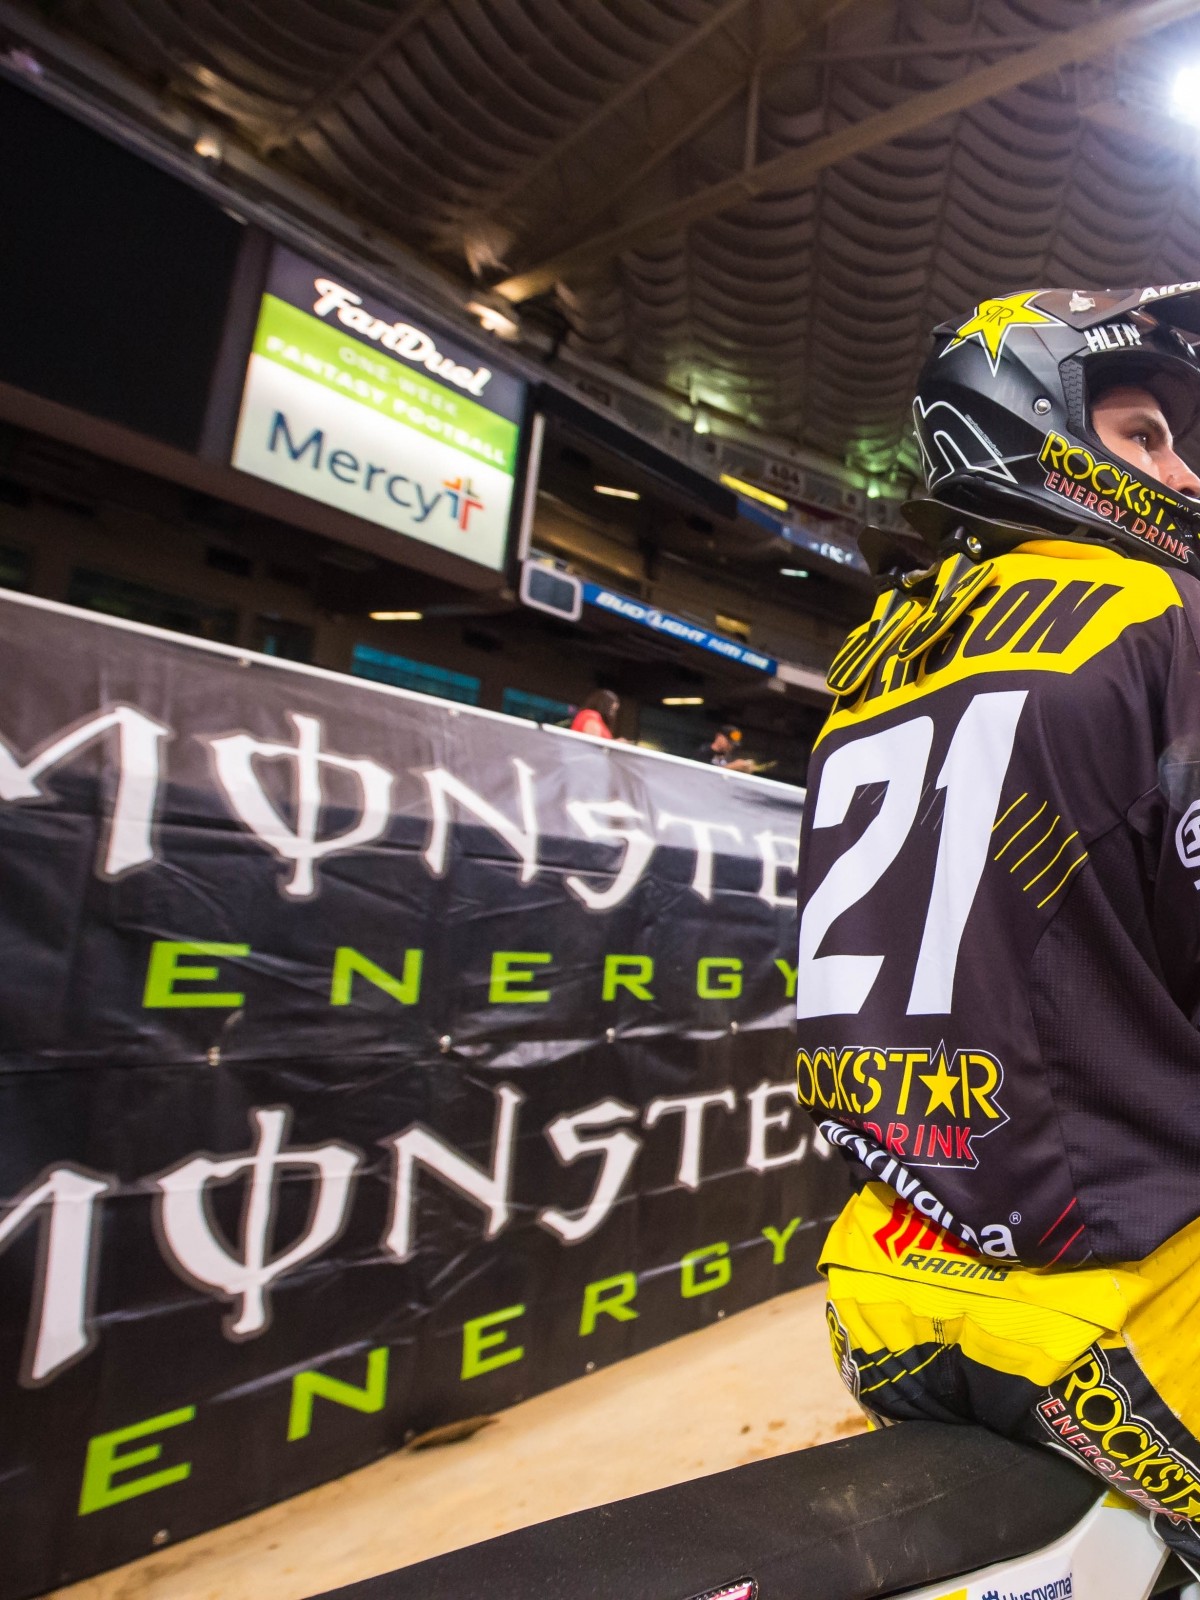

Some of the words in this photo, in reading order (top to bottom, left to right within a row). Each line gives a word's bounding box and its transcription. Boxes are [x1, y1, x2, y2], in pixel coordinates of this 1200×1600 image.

[313, 277, 492, 397] FanDuel
[265, 336, 388, 405] FANTASY
[392, 399, 507, 467] FOOTBALL
[268, 410, 442, 523] Mercy
[1047, 471, 1128, 523] ENERGY
[1131, 517, 1189, 561] DRINK
[797, 690, 1029, 1019] 21
[901, 1252, 1009, 1282] RACING
[79, 1217, 802, 1516] ENERGY
[1041, 1398, 1131, 1482] ENERGY
